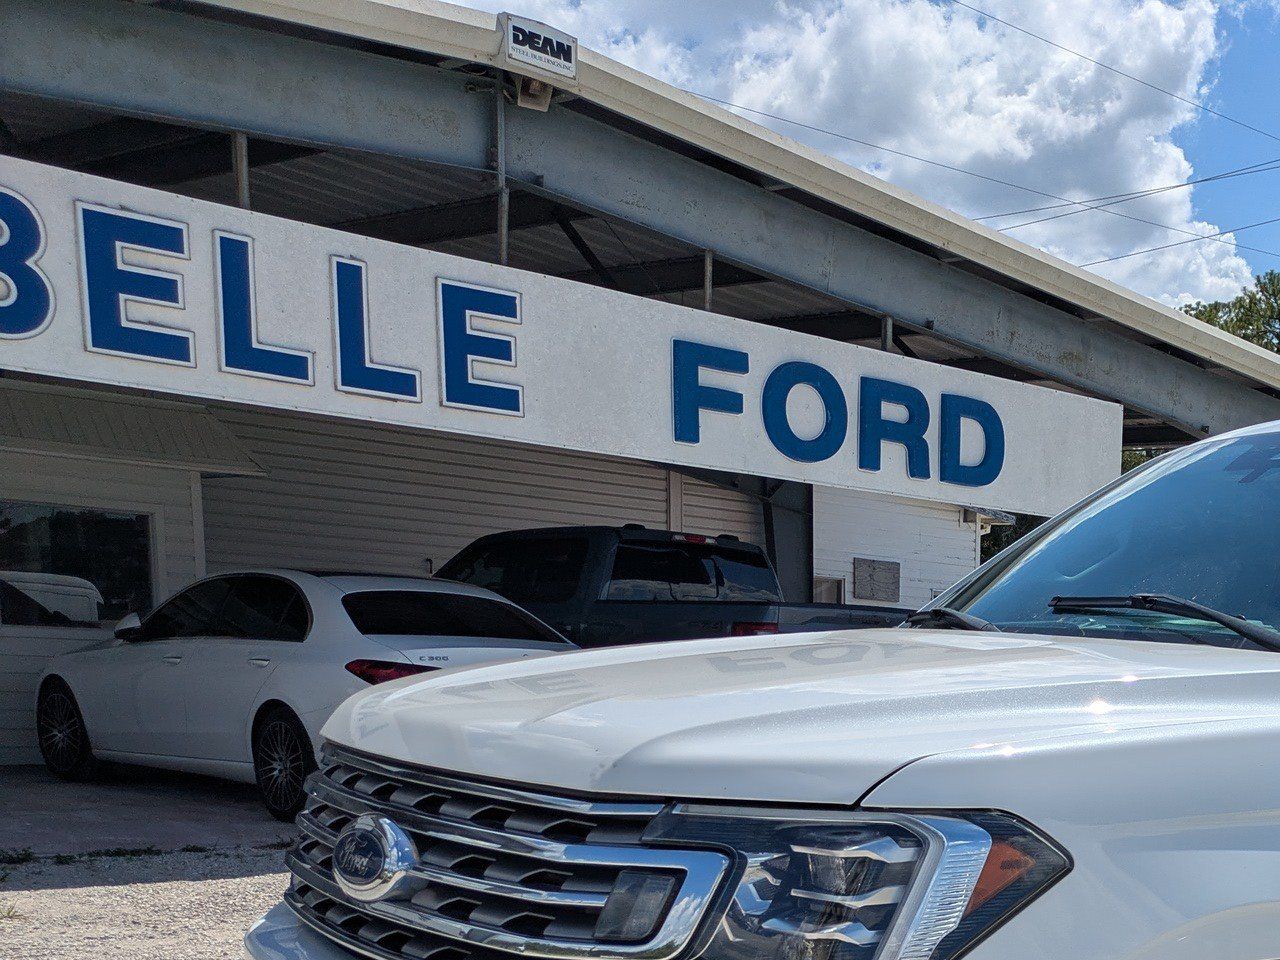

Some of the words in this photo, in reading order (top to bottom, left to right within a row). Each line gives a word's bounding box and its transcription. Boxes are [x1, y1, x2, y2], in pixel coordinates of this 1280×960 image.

[512, 24, 572, 63] DEAN
[672, 338, 1006, 488] FORD
[338, 835, 375, 876] Ford
